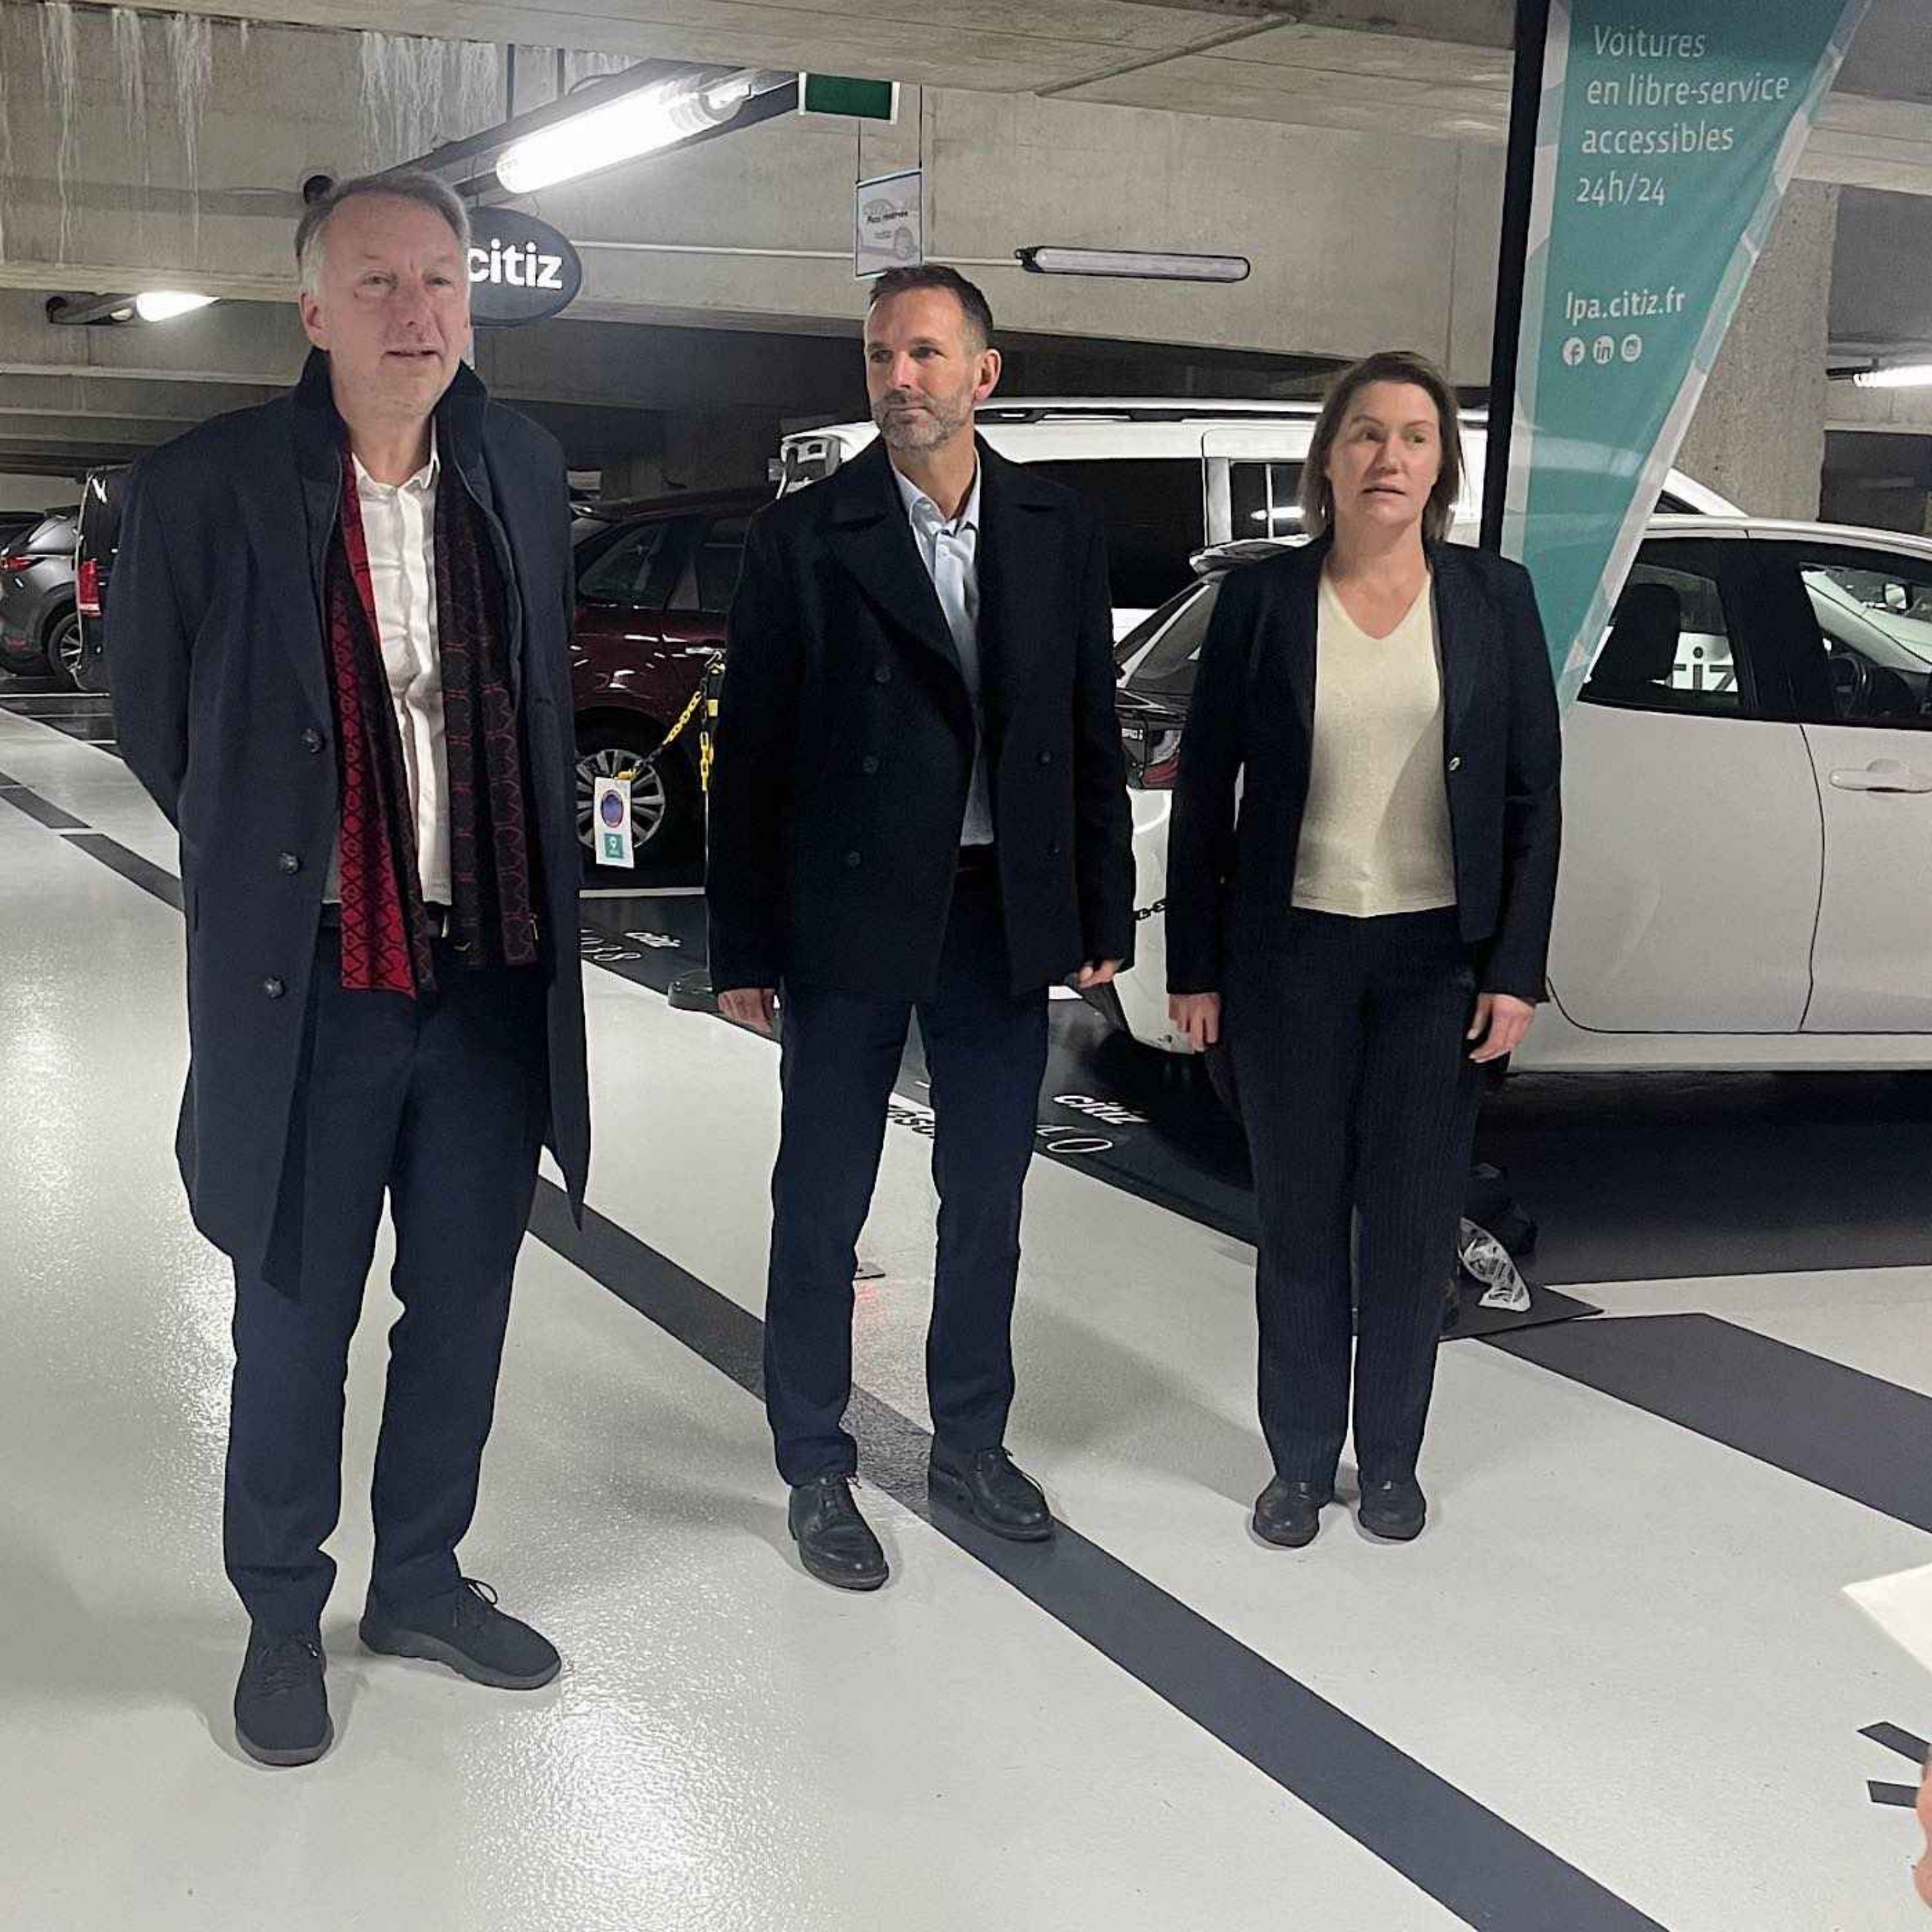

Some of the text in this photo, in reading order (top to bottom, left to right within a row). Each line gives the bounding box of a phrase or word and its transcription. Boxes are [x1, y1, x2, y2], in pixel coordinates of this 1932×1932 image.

[1593, 25, 1707, 57] Voitures
[1587, 73, 1790, 106] en libre-service
[1581, 120, 1734, 154] accessibles
[1576, 171, 1666, 205] 24h/24
[468, 238, 563, 289] citiz
[1565, 287, 1685, 325] lpa.citiz.fr
